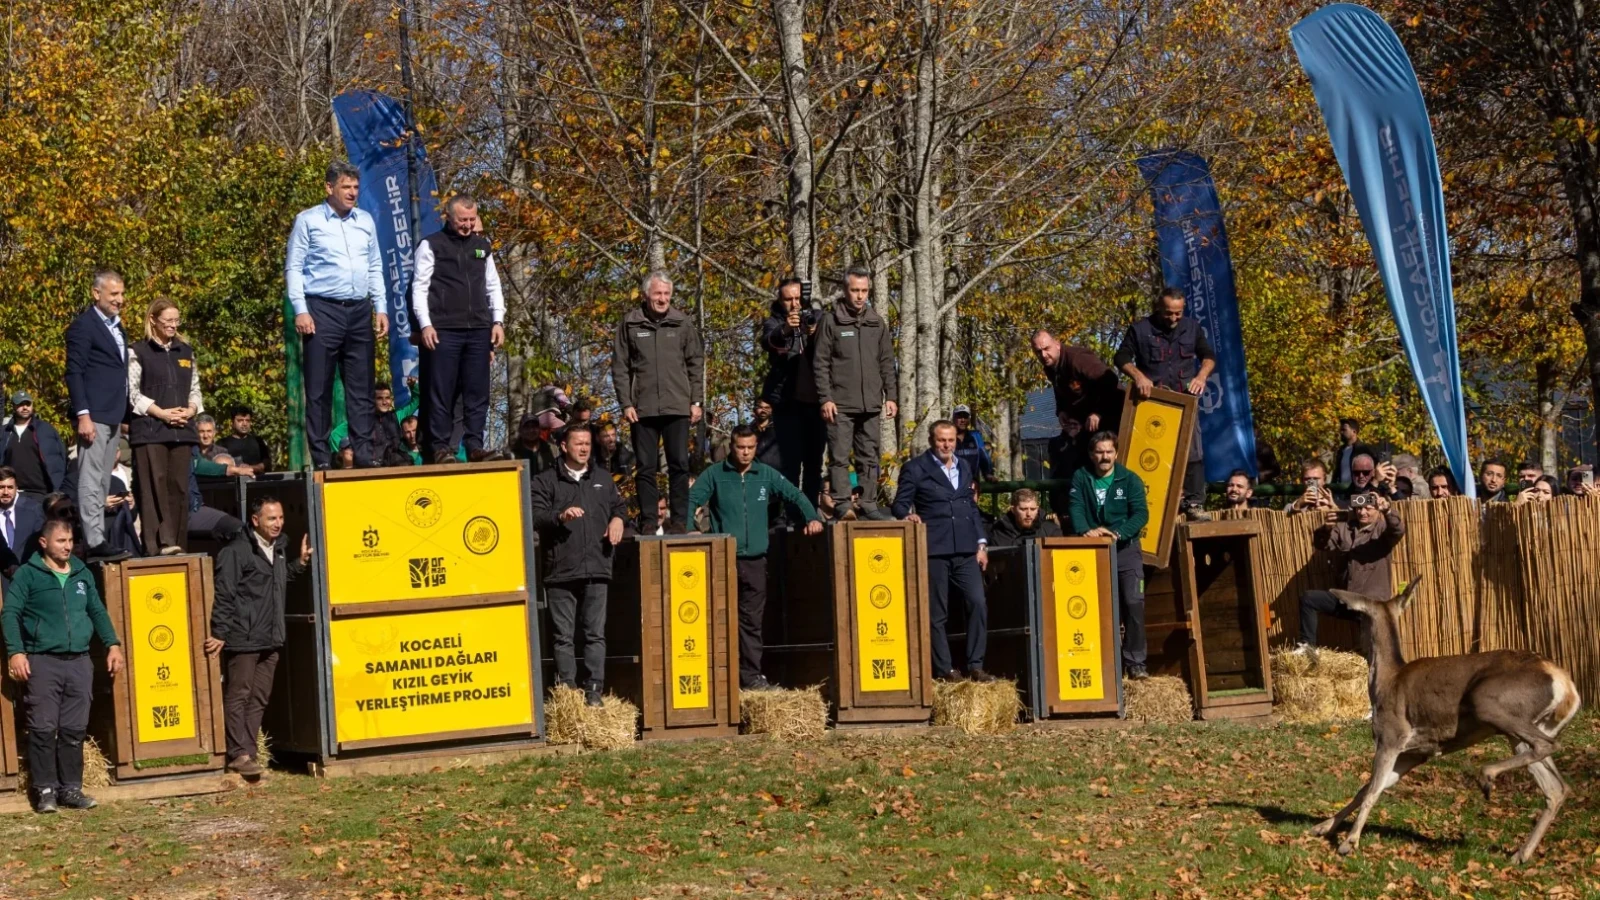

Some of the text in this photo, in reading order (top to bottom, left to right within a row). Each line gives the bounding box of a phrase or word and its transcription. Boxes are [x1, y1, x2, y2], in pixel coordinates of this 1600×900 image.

[400, 633, 463, 653] KOCAELİ
[365, 651, 498, 675] SAMANLI DAĞLARI
[392, 670, 473, 690] KIZIL GEYİK
[355, 683, 512, 712] YERLEŞTİRME PROJESİ
